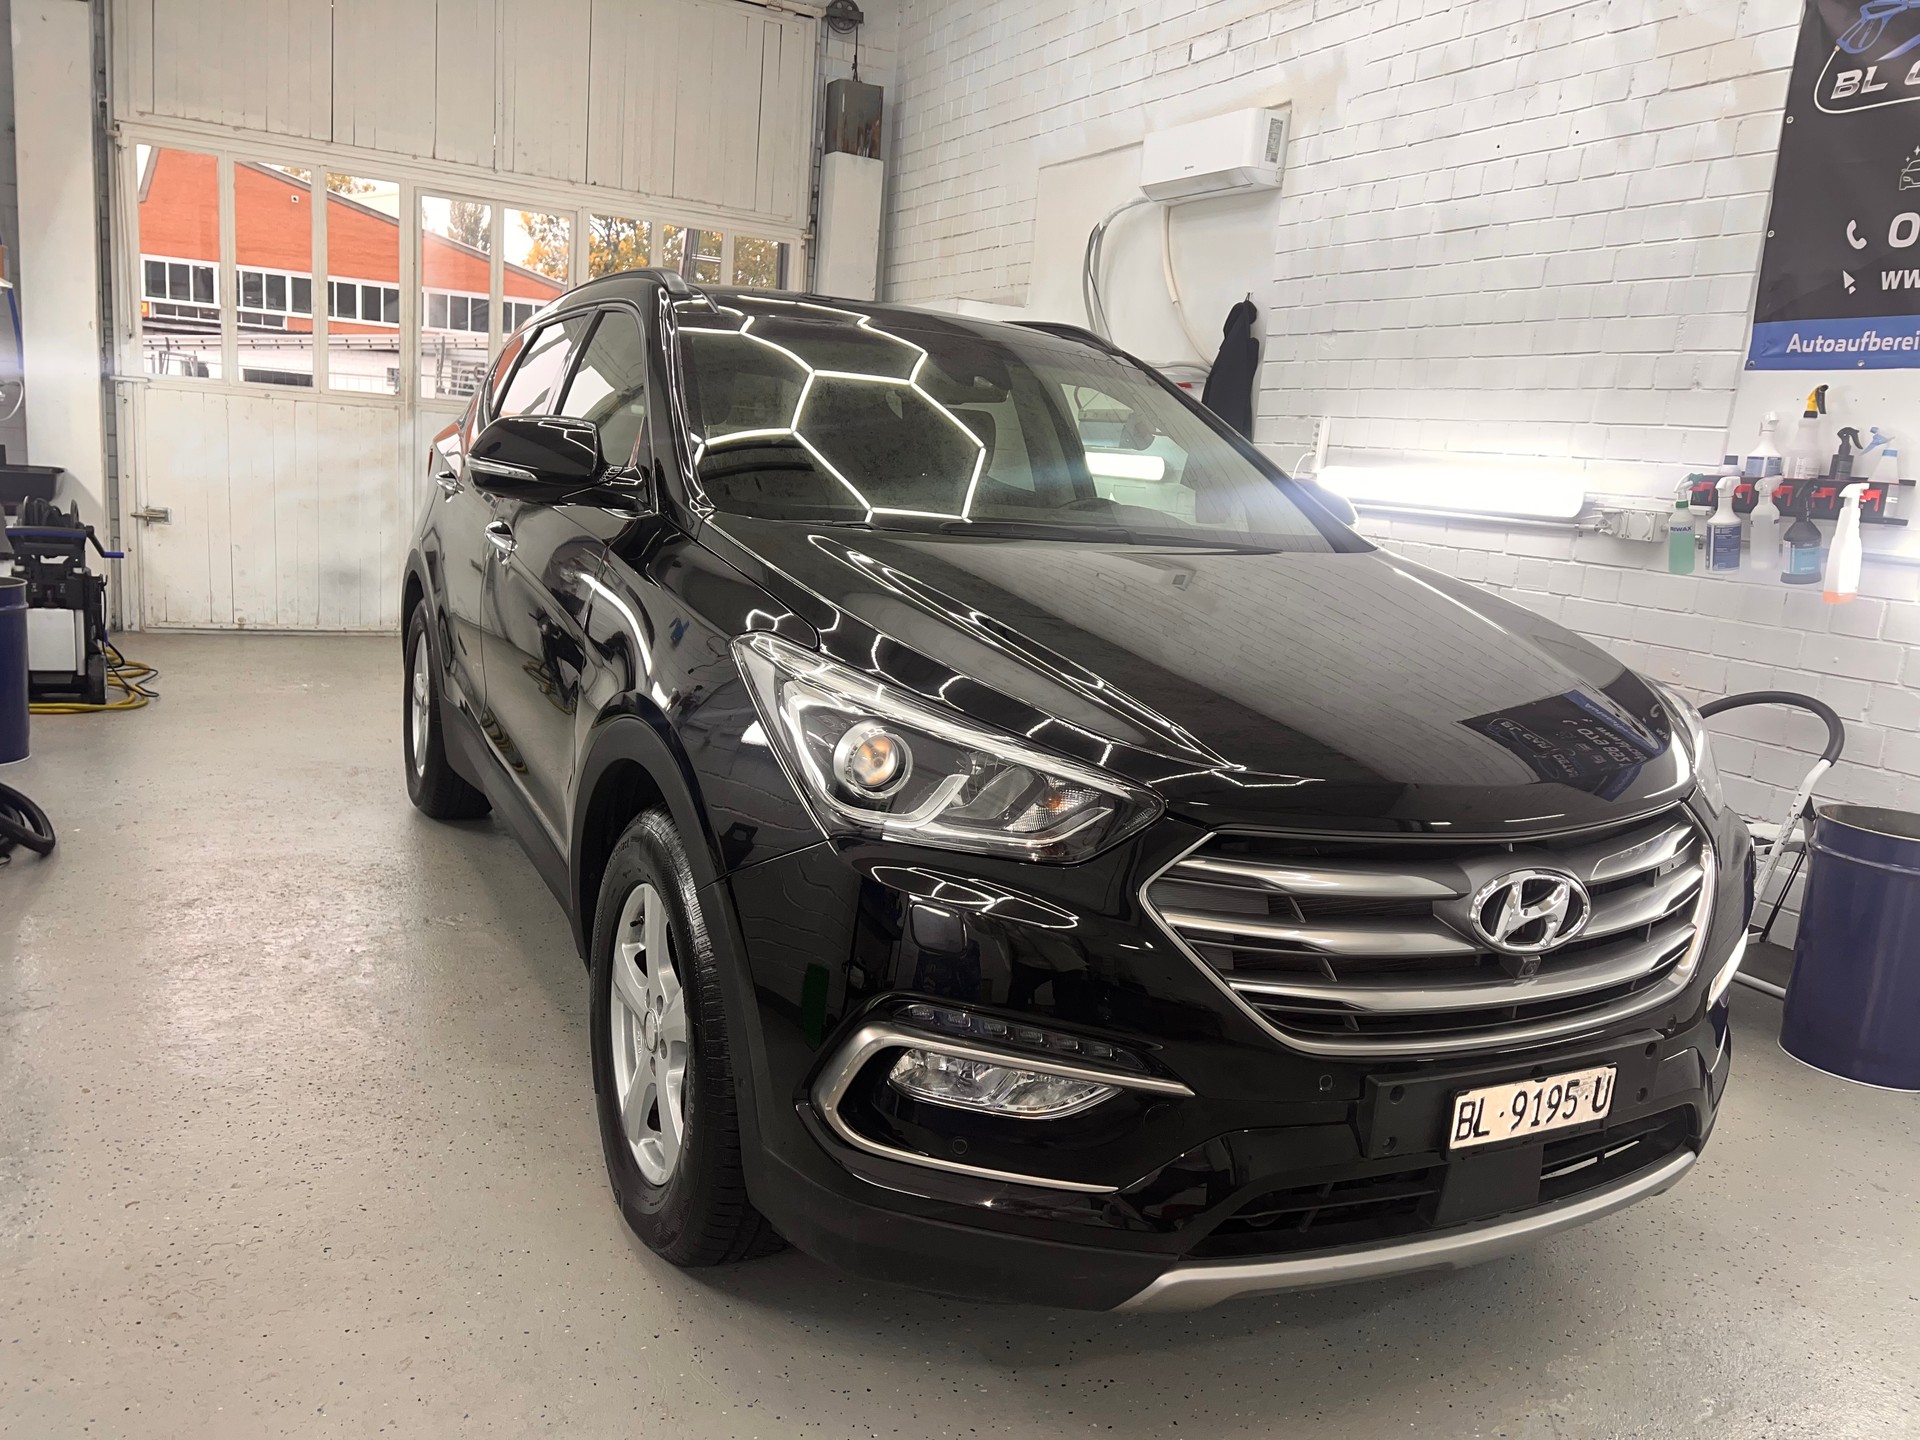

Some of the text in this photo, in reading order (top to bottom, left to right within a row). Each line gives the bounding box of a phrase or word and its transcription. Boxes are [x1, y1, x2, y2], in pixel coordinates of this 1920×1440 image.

[1831, 66, 1888, 100] BL
[1785, 330, 1920, 354] Autoaufberei
[1455, 1096, 1490, 1141] BL
[1510, 1079, 1580, 1132] 9195
